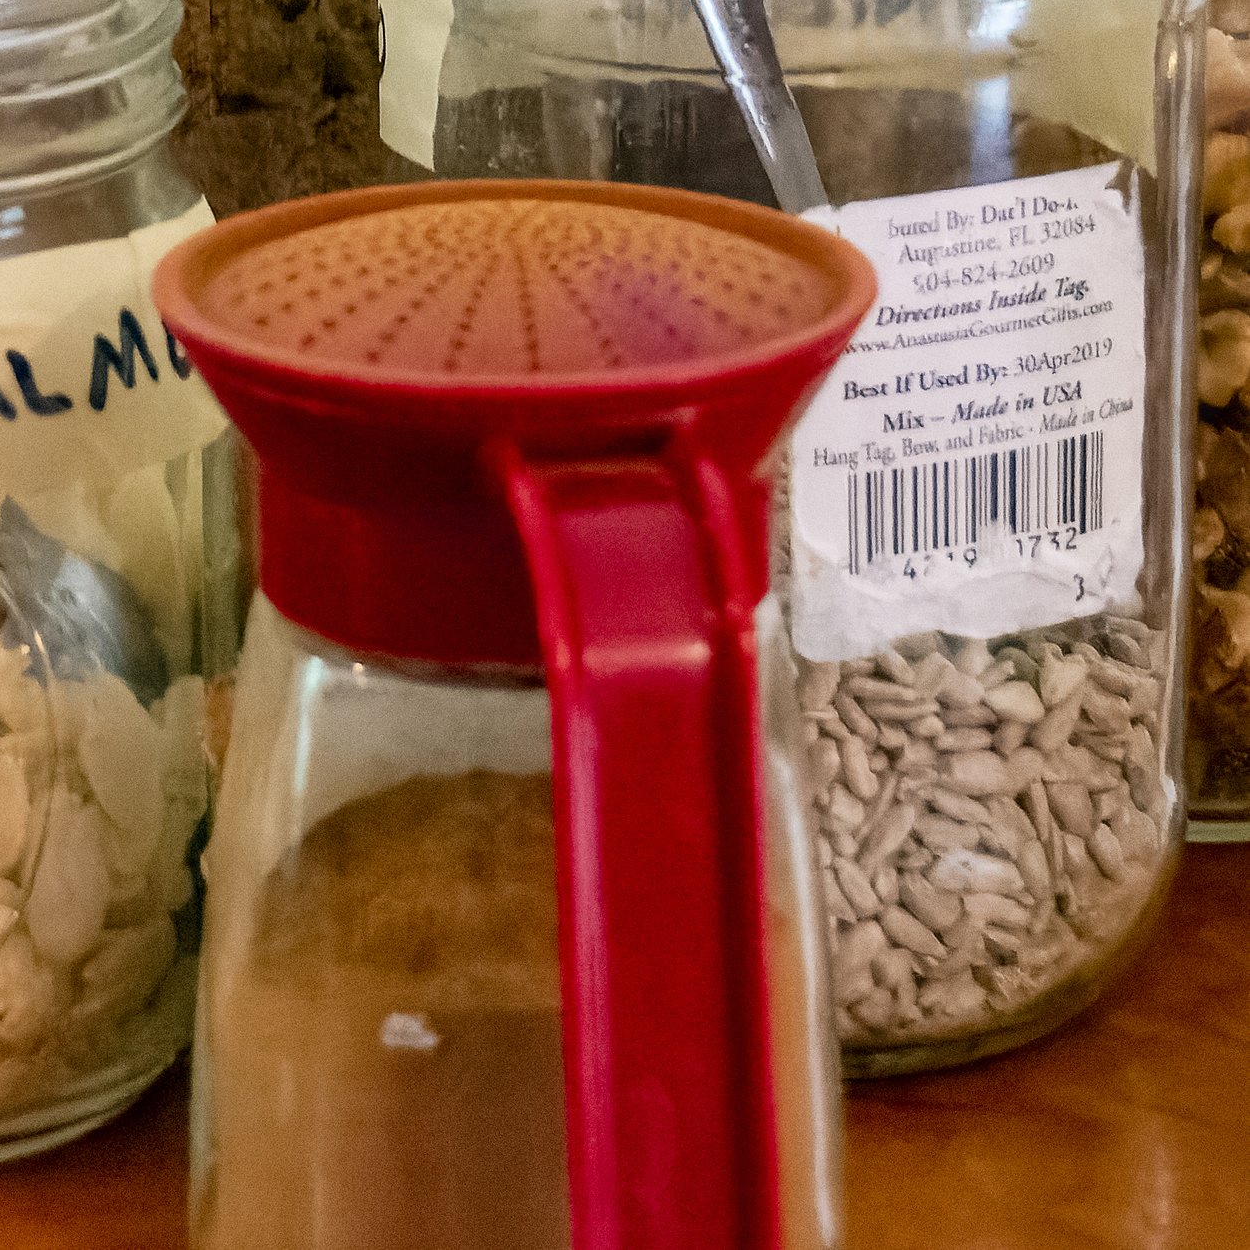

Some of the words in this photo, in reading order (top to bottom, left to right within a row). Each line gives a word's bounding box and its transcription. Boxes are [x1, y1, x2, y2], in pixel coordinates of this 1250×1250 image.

[946, 209, 976, 233] By:
[1008, 225, 1036, 247] FL
[1040, 213, 1096, 242] 32084
[875, 298, 982, 327] Directions
[988, 281, 1047, 310] Inside
[843, 381, 888, 400] Best
[895, 371, 915, 393] If
[918, 365, 969, 391] Used
[975, 361, 1009, 388] By:
[1014, 337, 1113, 376] 30Apr2019
[882, 409, 925, 433] Mix
[952, 396, 1009, 424] Made
[1015, 392, 1036, 412] in
[1042, 380, 1083, 405] USA
[813, 446, 859, 471] Hang
[945, 427, 974, 452] and
[979, 424, 1025, 445] Fabric
[1039, 408, 1079, 434] Made
[1082, 405, 1095, 422] in
[1099, 396, 1134, 420] China
